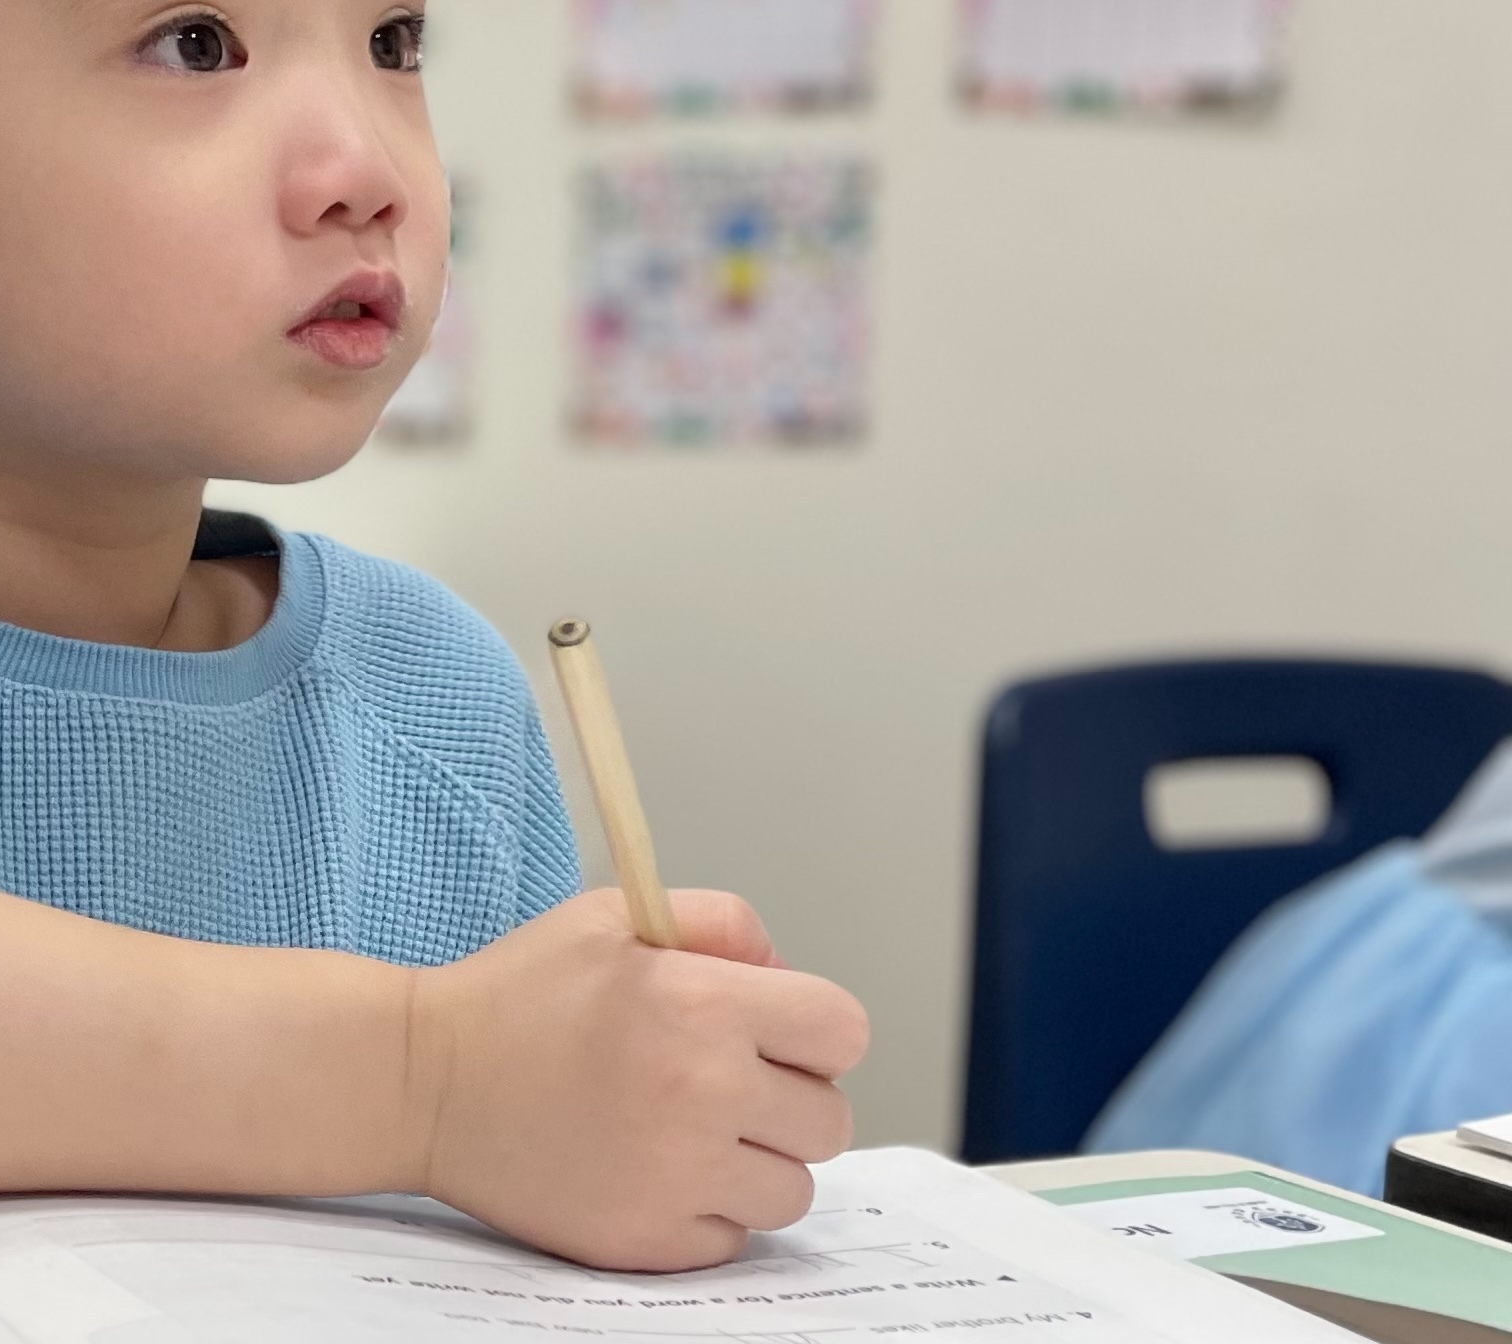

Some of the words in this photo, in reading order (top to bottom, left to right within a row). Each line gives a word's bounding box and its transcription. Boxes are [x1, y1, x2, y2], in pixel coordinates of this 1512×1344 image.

[922, 1241, 950, 1250] 5.
[408, 1280, 476, 1292] write
[913, 1278, 988, 1289] Write
[481, 1288, 528, 1299] not
[777, 1285, 886, 1300] sentence
[534, 1294, 576, 1304] did
[583, 1298, 633, 1307] you
[639, 1299, 706, 1309] word
[736, 1295, 774, 1304] for
[1024, 1313, 1068, 1323] My
[1067, 1311, 1094, 1320] 4.
[933, 1316, 1024, 1330] brother
[869, 1322, 929, 1335] likes
